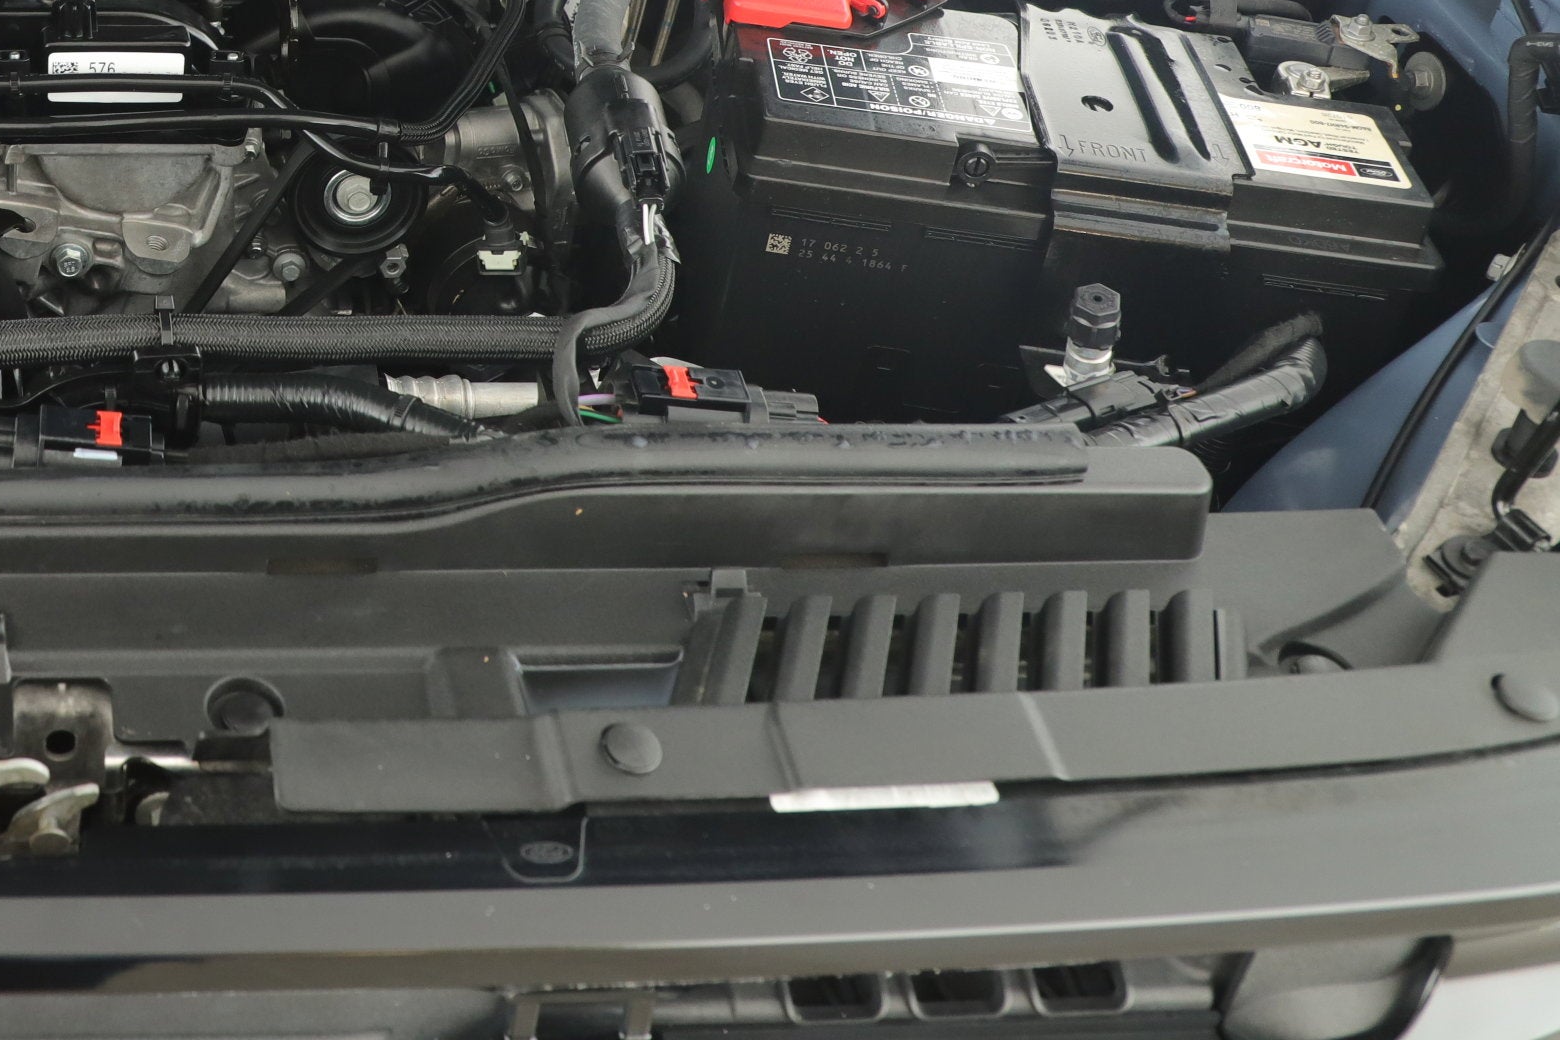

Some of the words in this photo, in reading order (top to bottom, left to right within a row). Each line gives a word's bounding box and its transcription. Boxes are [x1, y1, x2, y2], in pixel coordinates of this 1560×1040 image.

[827, 49, 857, 57] OPEN.
[89, 62, 116, 73] 576
[869, 103, 984, 124] DANGER/POISON
[1078, 139, 1147, 162] FRONT
[1274, 135, 1321, 149] AGM
[1264, 153, 1347, 173] Motorcraft
[801, 238, 816, 248] 17
[824, 241, 847, 253] 062
[856, 246, 864, 255] 2
[871, 248, 879, 257] 5
[798, 249, 813, 259] 25
[821, 253, 836, 263] 44
[862, 258, 891, 270] 1864
[900, 264, 908, 272] F
